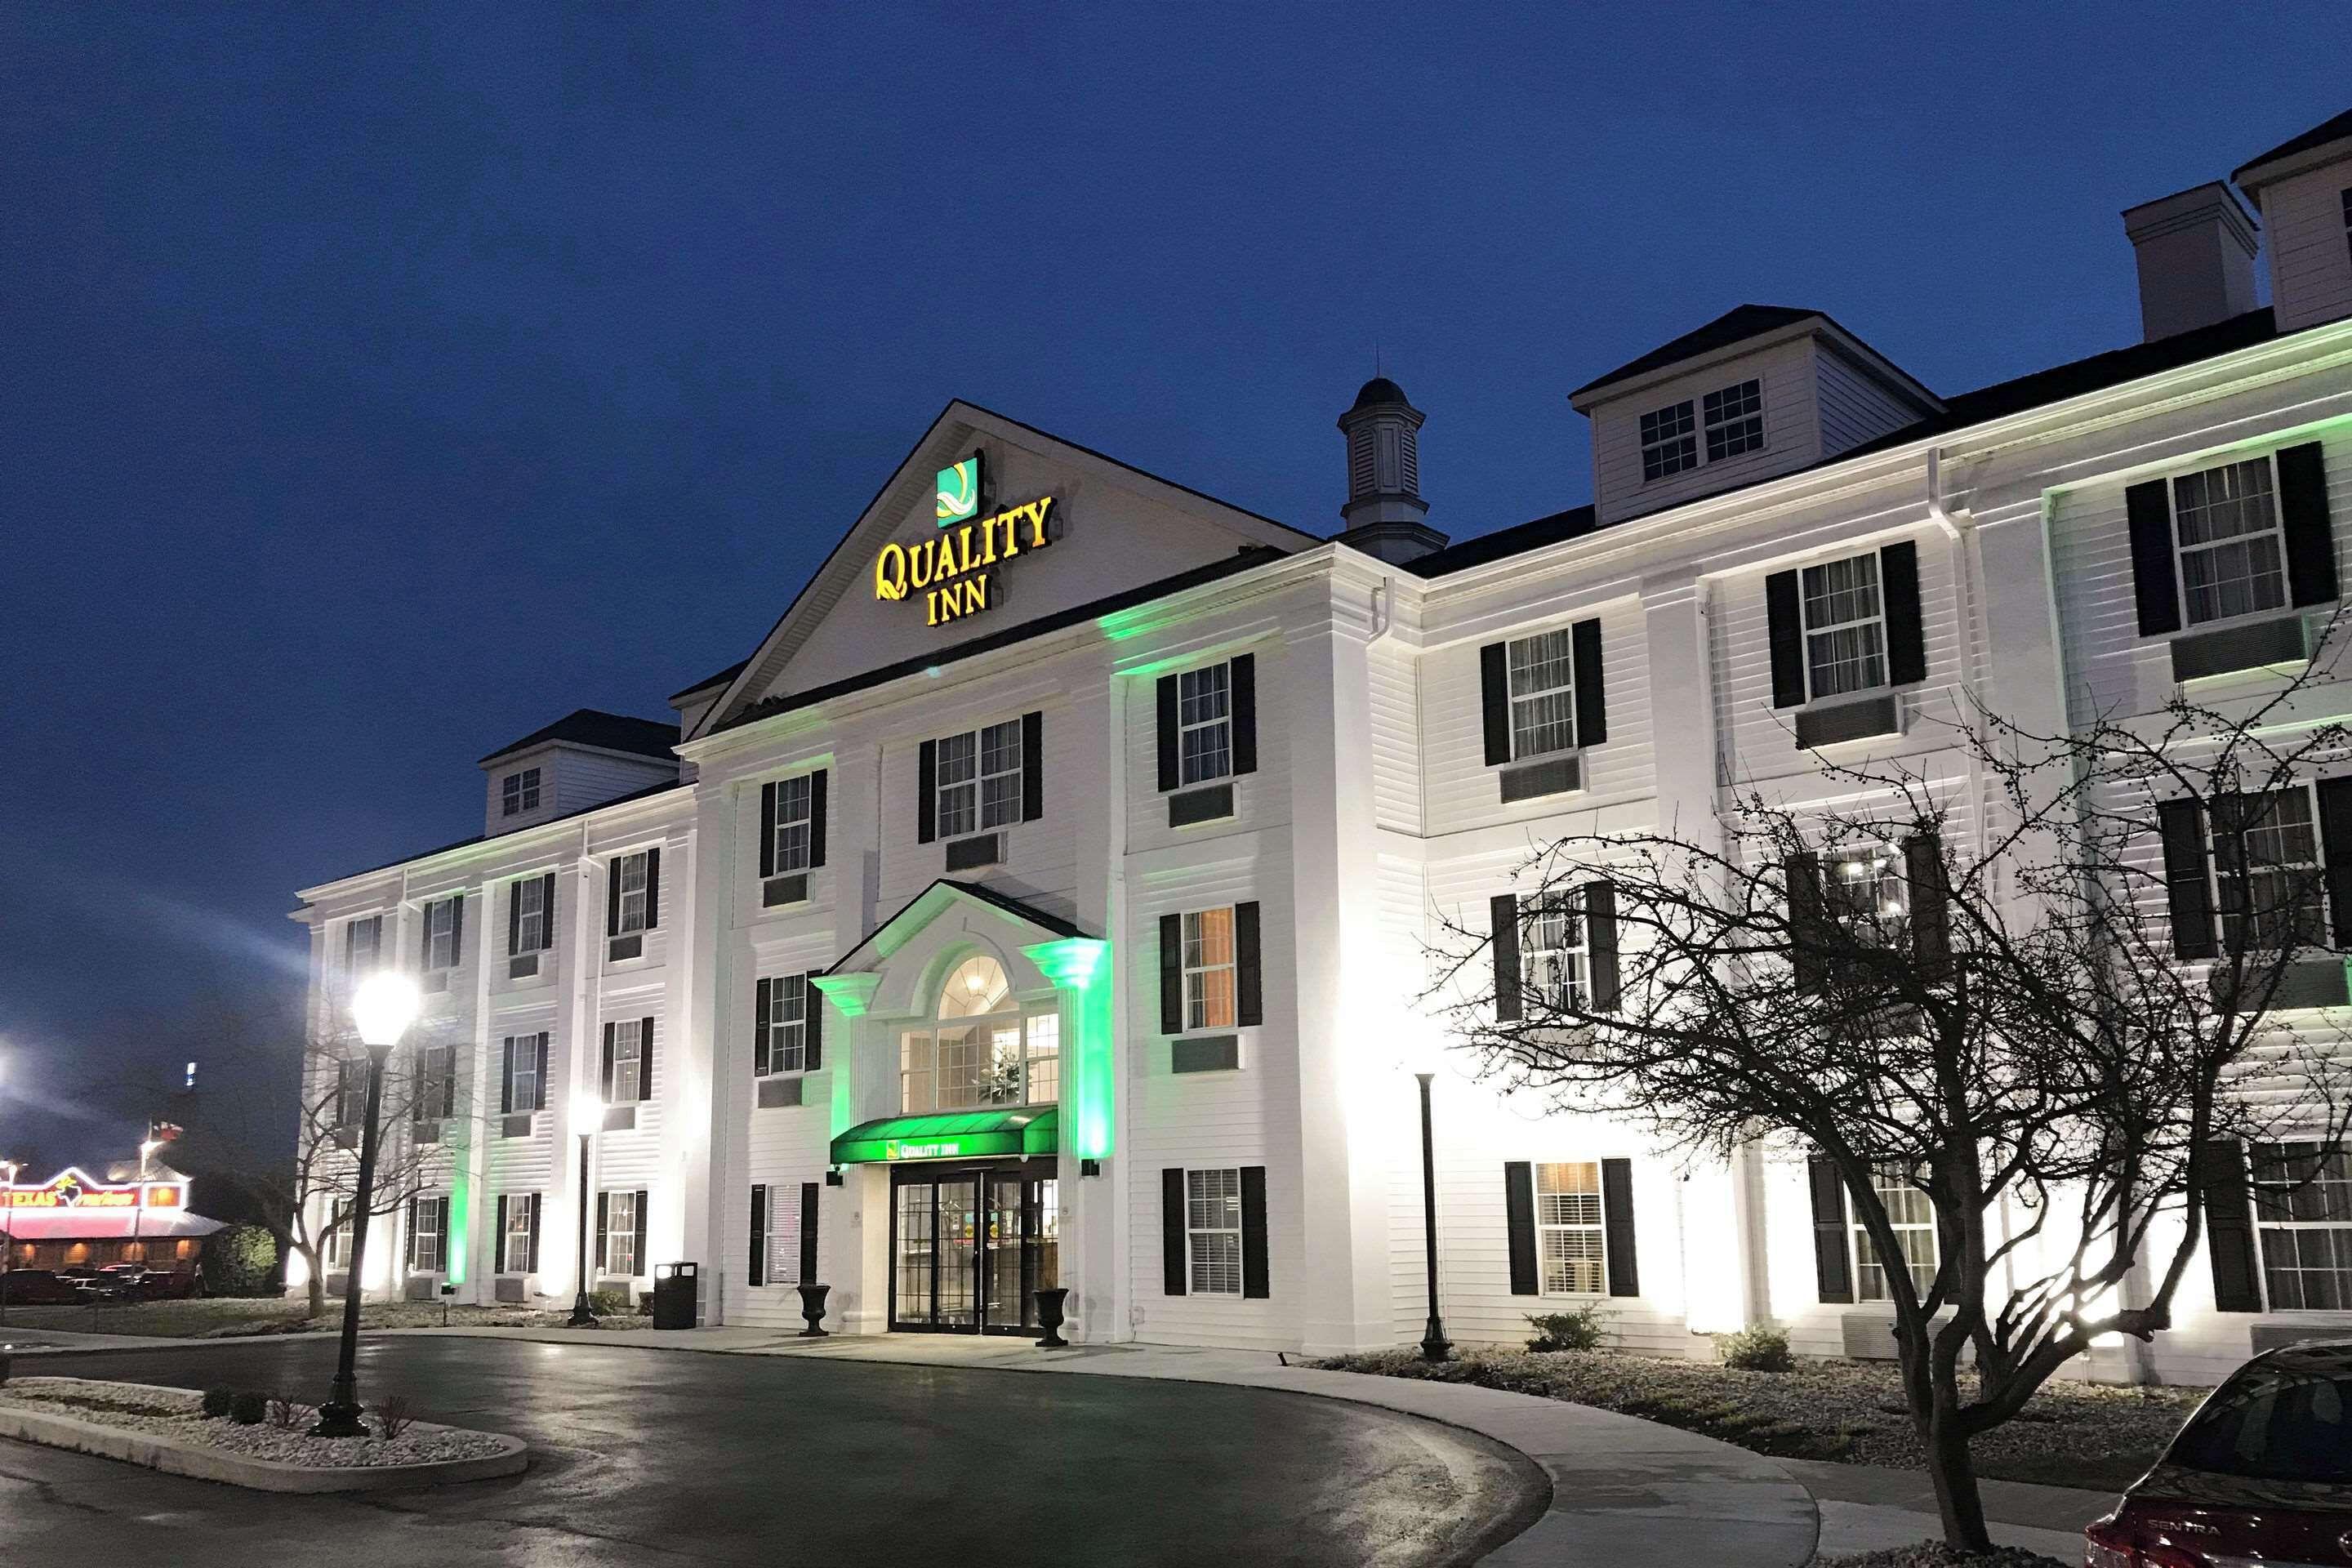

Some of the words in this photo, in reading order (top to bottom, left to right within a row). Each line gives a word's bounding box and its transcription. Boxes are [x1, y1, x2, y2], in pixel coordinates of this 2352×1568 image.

[875, 497, 1052, 601] QUALITY
[927, 574, 987, 626] INN
[940, 1143, 960, 1156] INN
[2, 1191, 57, 1206] TEXAS
[2147, 1519, 2221, 1535] SENTRA
